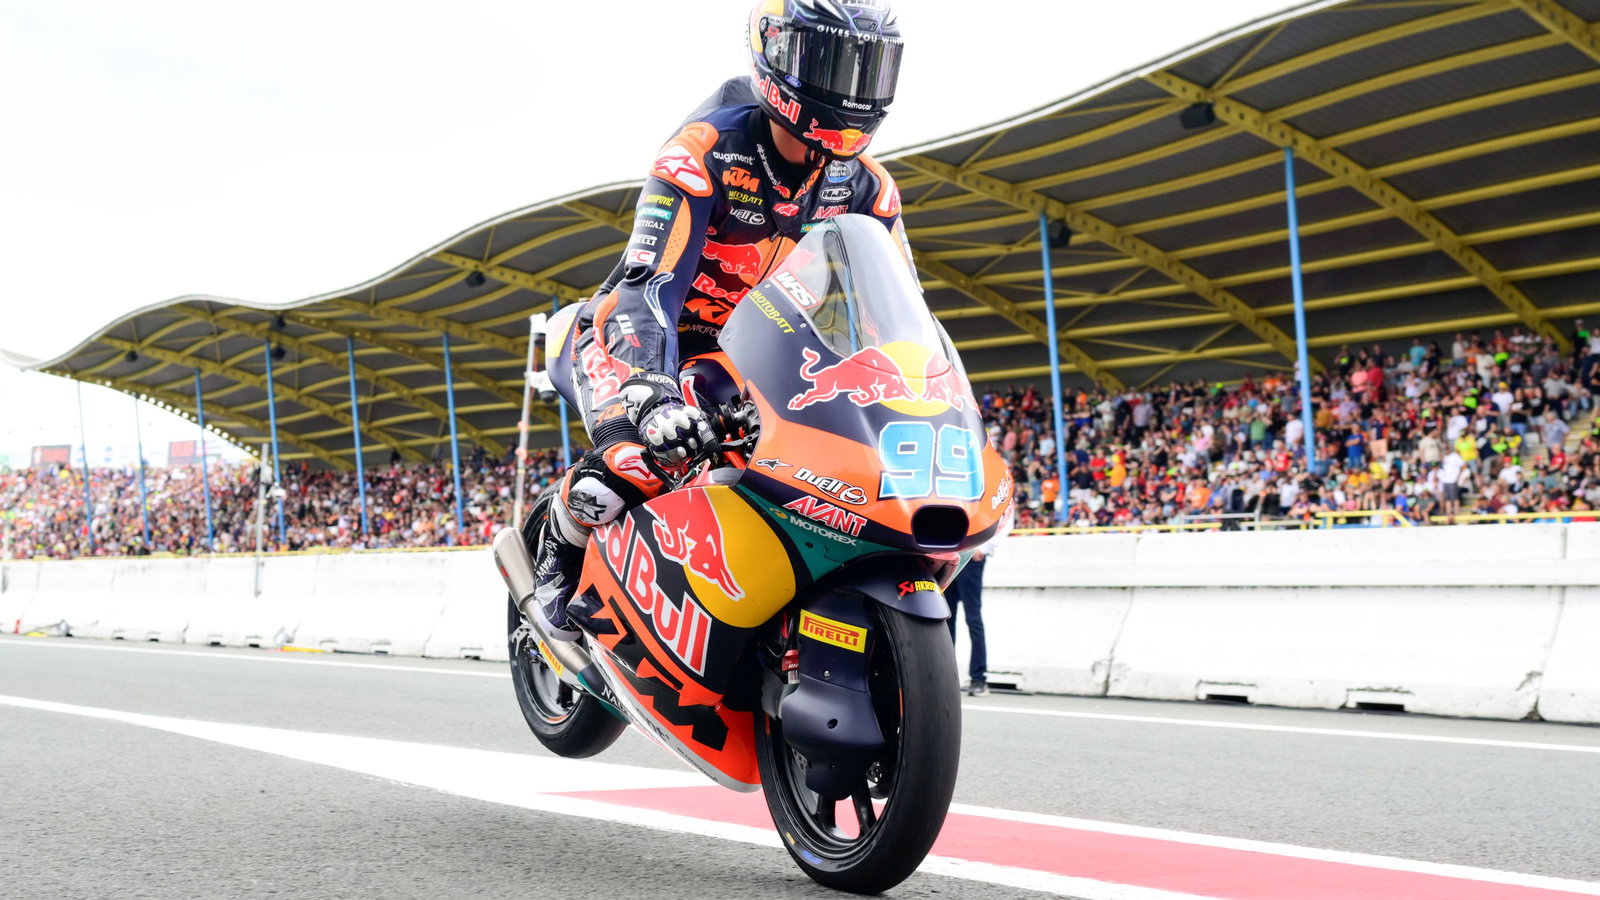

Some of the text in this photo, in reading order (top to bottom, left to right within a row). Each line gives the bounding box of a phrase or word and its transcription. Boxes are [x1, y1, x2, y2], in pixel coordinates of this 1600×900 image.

[817, 25, 850, 37] GIVES
[857, 33, 877, 43] YOU
[767, 81, 802, 124] Bull
[842, 99, 872, 110] Romacar
[712, 151, 754, 165] augment
[722, 166, 760, 193] KTM
[822, 189, 850, 199] HJC
[692, 272, 751, 305] Red
[775, 271, 817, 306] WRS
[749, 290, 795, 334] MOTOBATT
[877, 420, 985, 502] 99
[782, 495, 868, 537] AVANT
[790, 516, 857, 546] MOTOREX
[625, 529, 712, 677] Bull
[803, 616, 860, 647] PIRELLI
